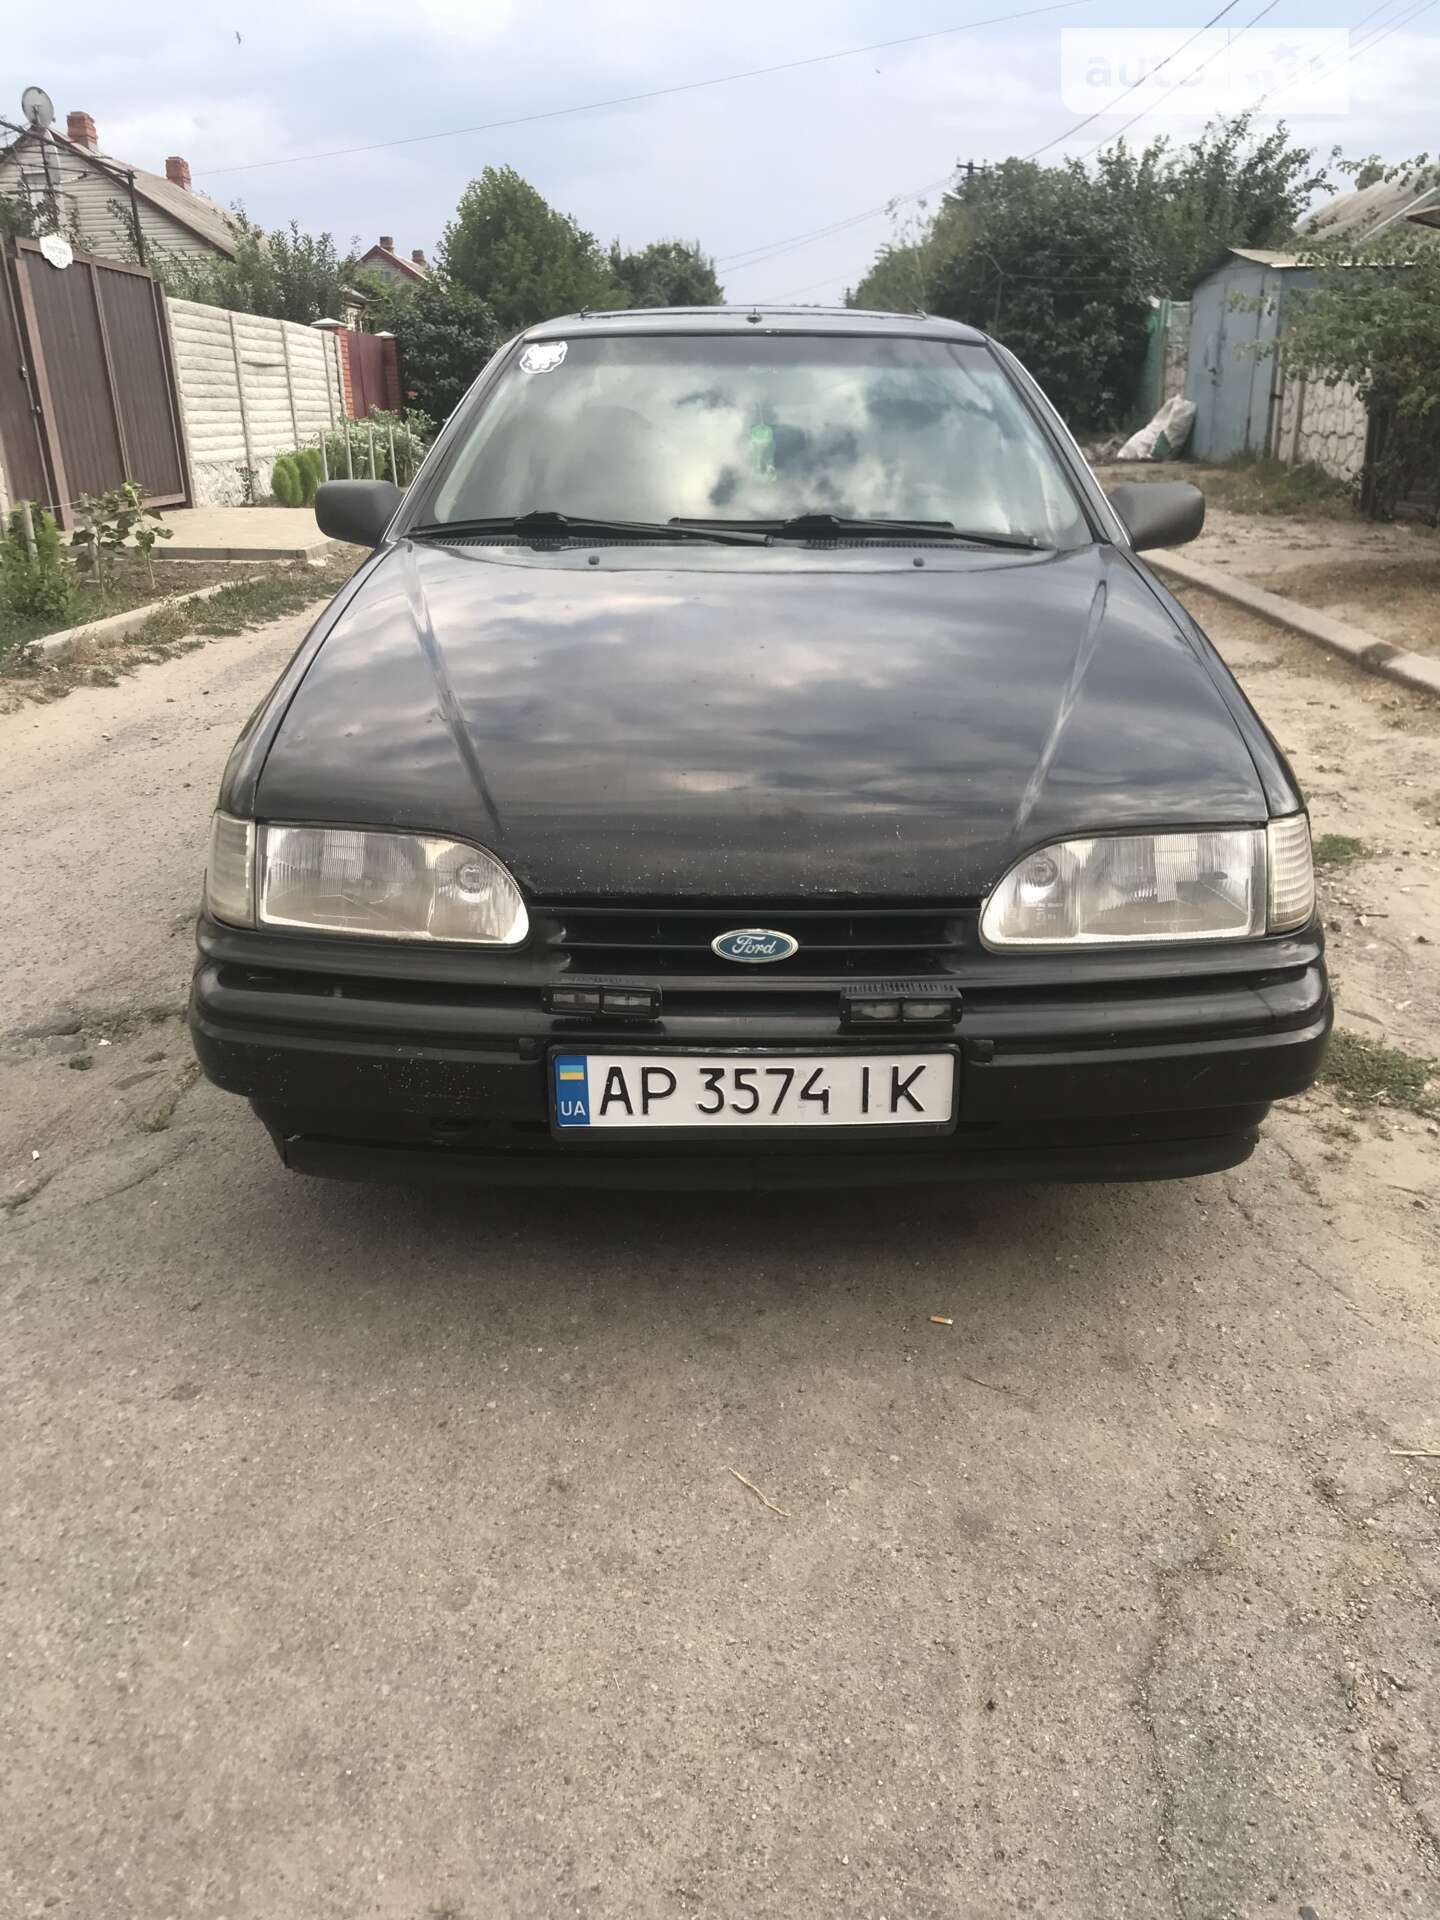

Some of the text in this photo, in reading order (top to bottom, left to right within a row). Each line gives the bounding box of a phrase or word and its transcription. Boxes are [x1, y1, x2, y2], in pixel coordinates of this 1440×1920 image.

[732, 935, 777, 954] Ford
[600, 1065, 926, 1115] AP 3574 IK
[561, 1101, 586, 1116] UA
